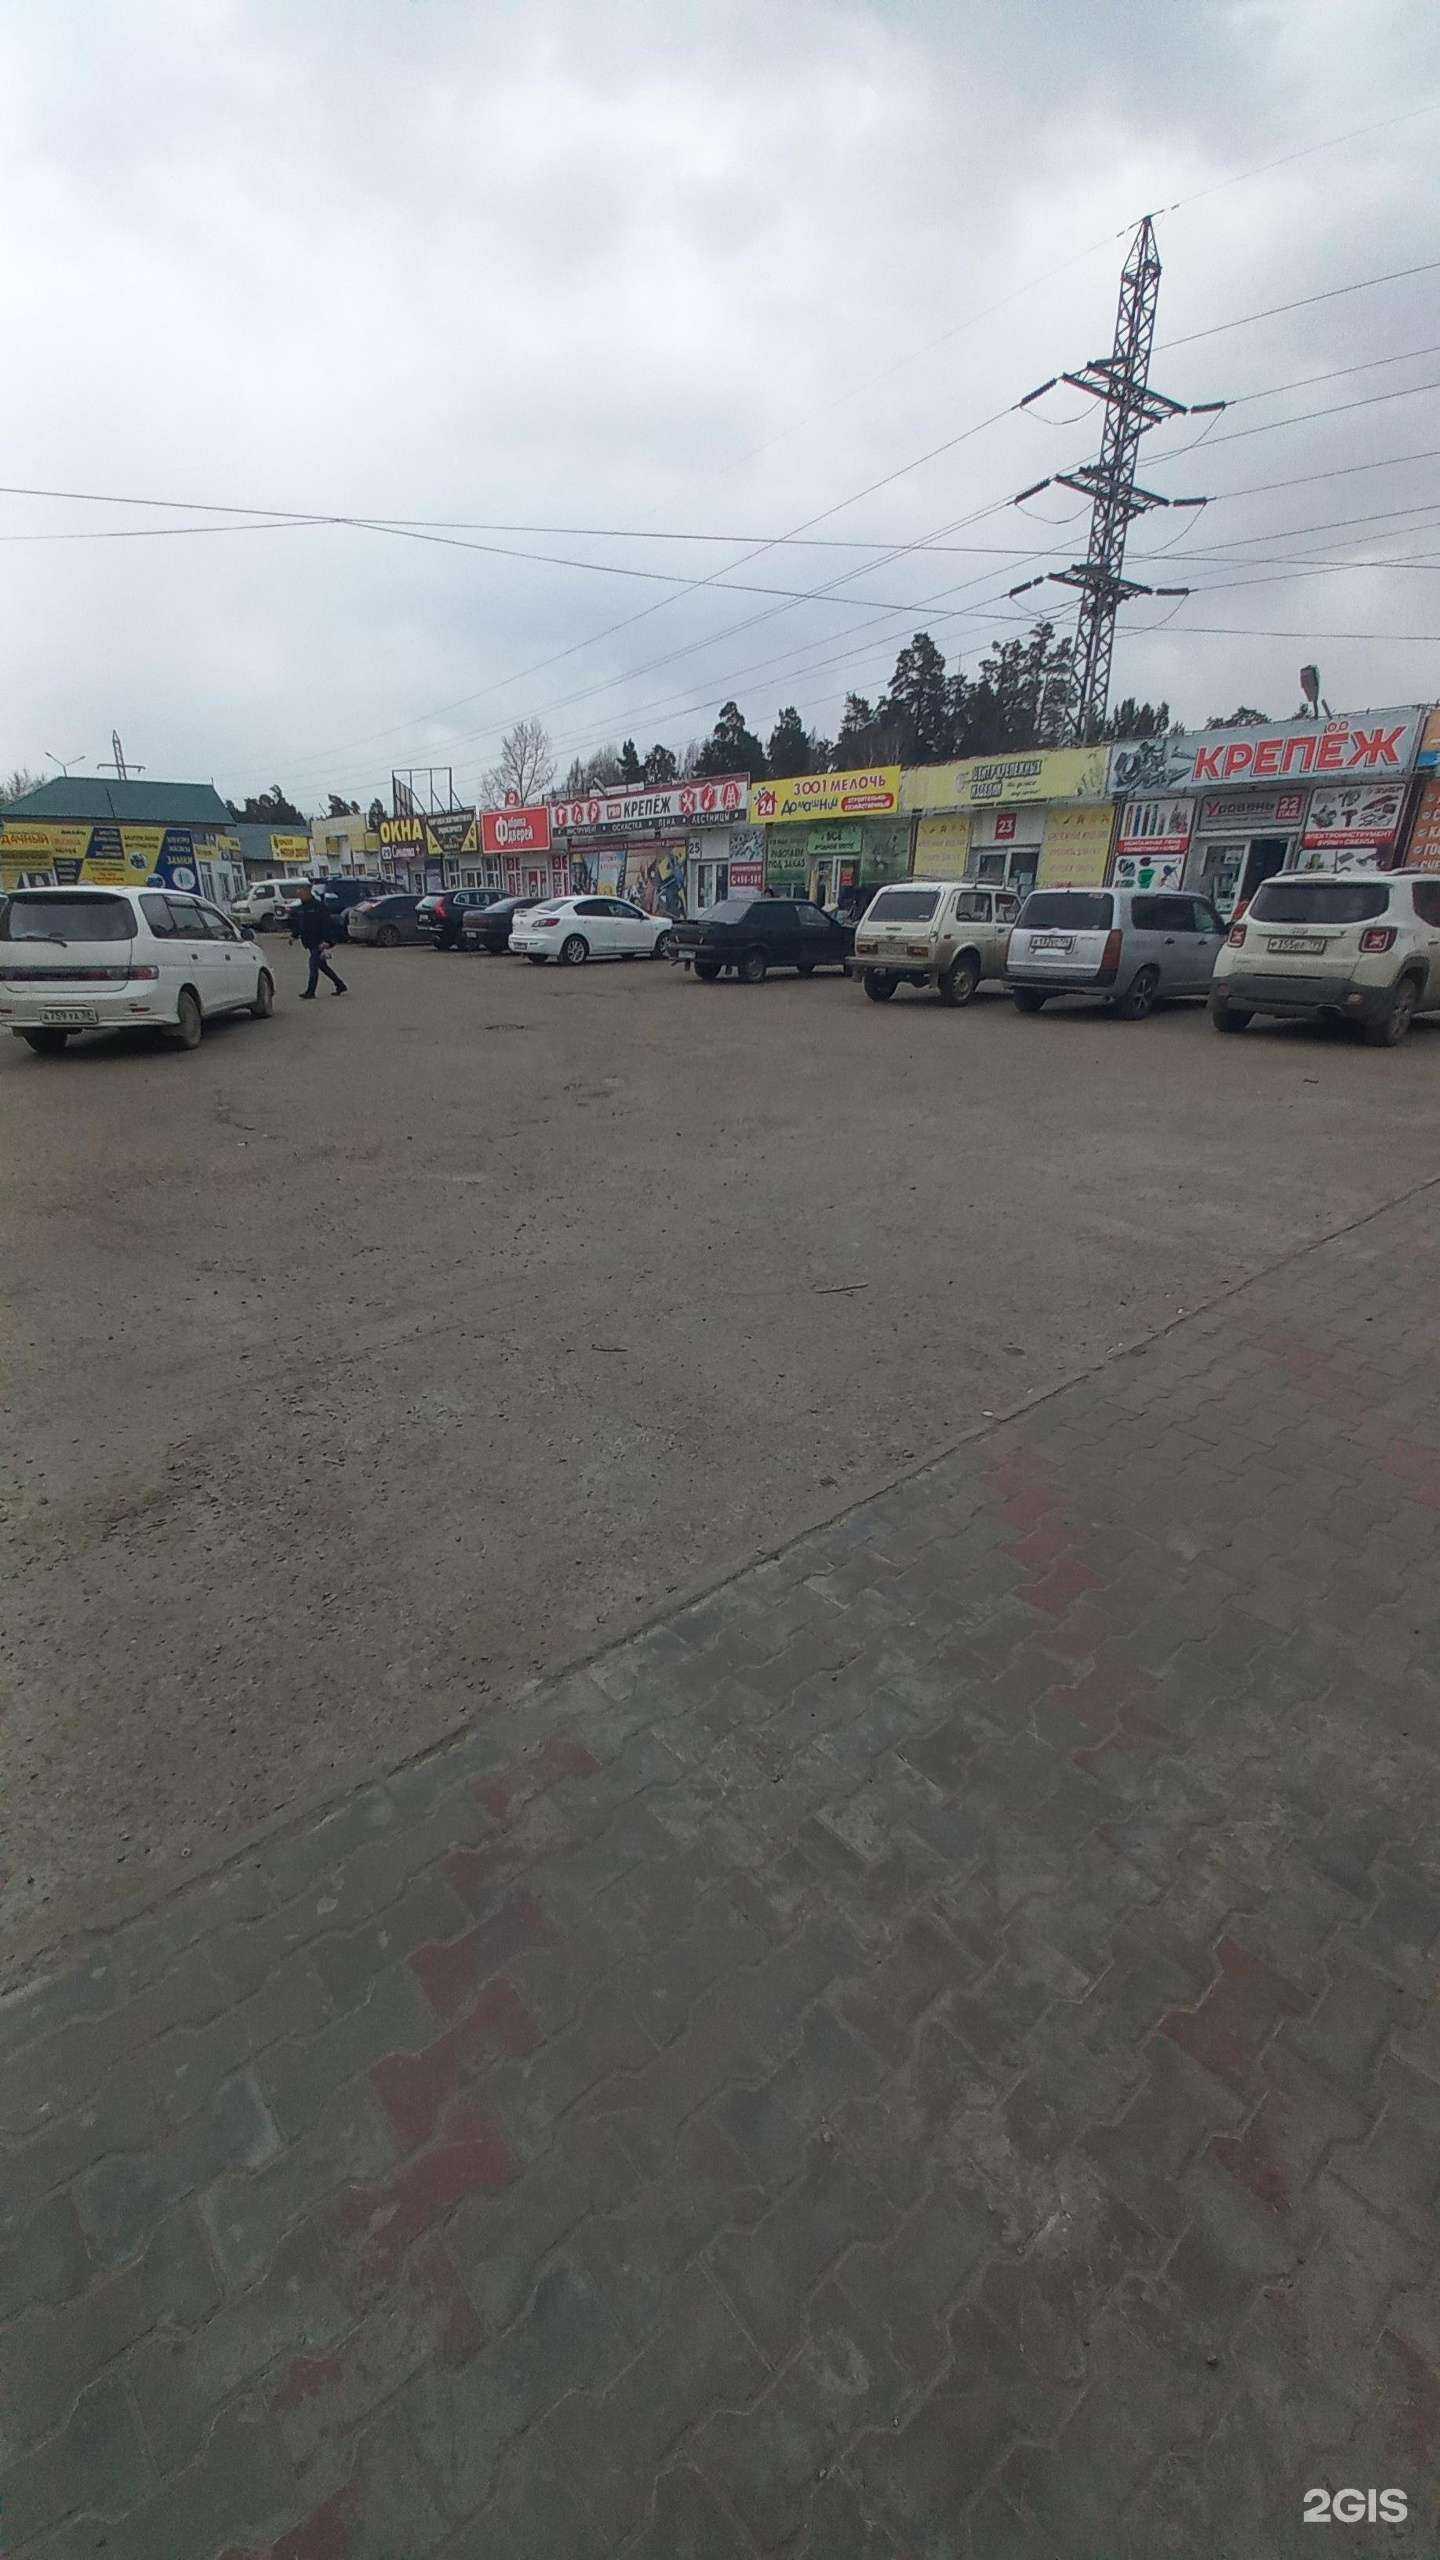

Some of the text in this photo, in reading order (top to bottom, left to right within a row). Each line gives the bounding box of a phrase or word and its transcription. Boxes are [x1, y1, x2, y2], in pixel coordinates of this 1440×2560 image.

[1191, 721, 1408, 782] КРЕПЁЖ
[830, 774, 886, 792] МЕЛОЧЬ
[623, 795, 672, 818] КРЕПЁЖ
[759, 801, 773, 815] 24
[1280, 797, 1299, 809] 22
[658, 819, 676, 829] ПЕНА
[691, 812, 730, 825] ЛЕСТНИЦЫ
[998, 819, 1014, 834] 23
[380, 818, 423, 844] ОКНА
[688, 842, 701, 854] 25
